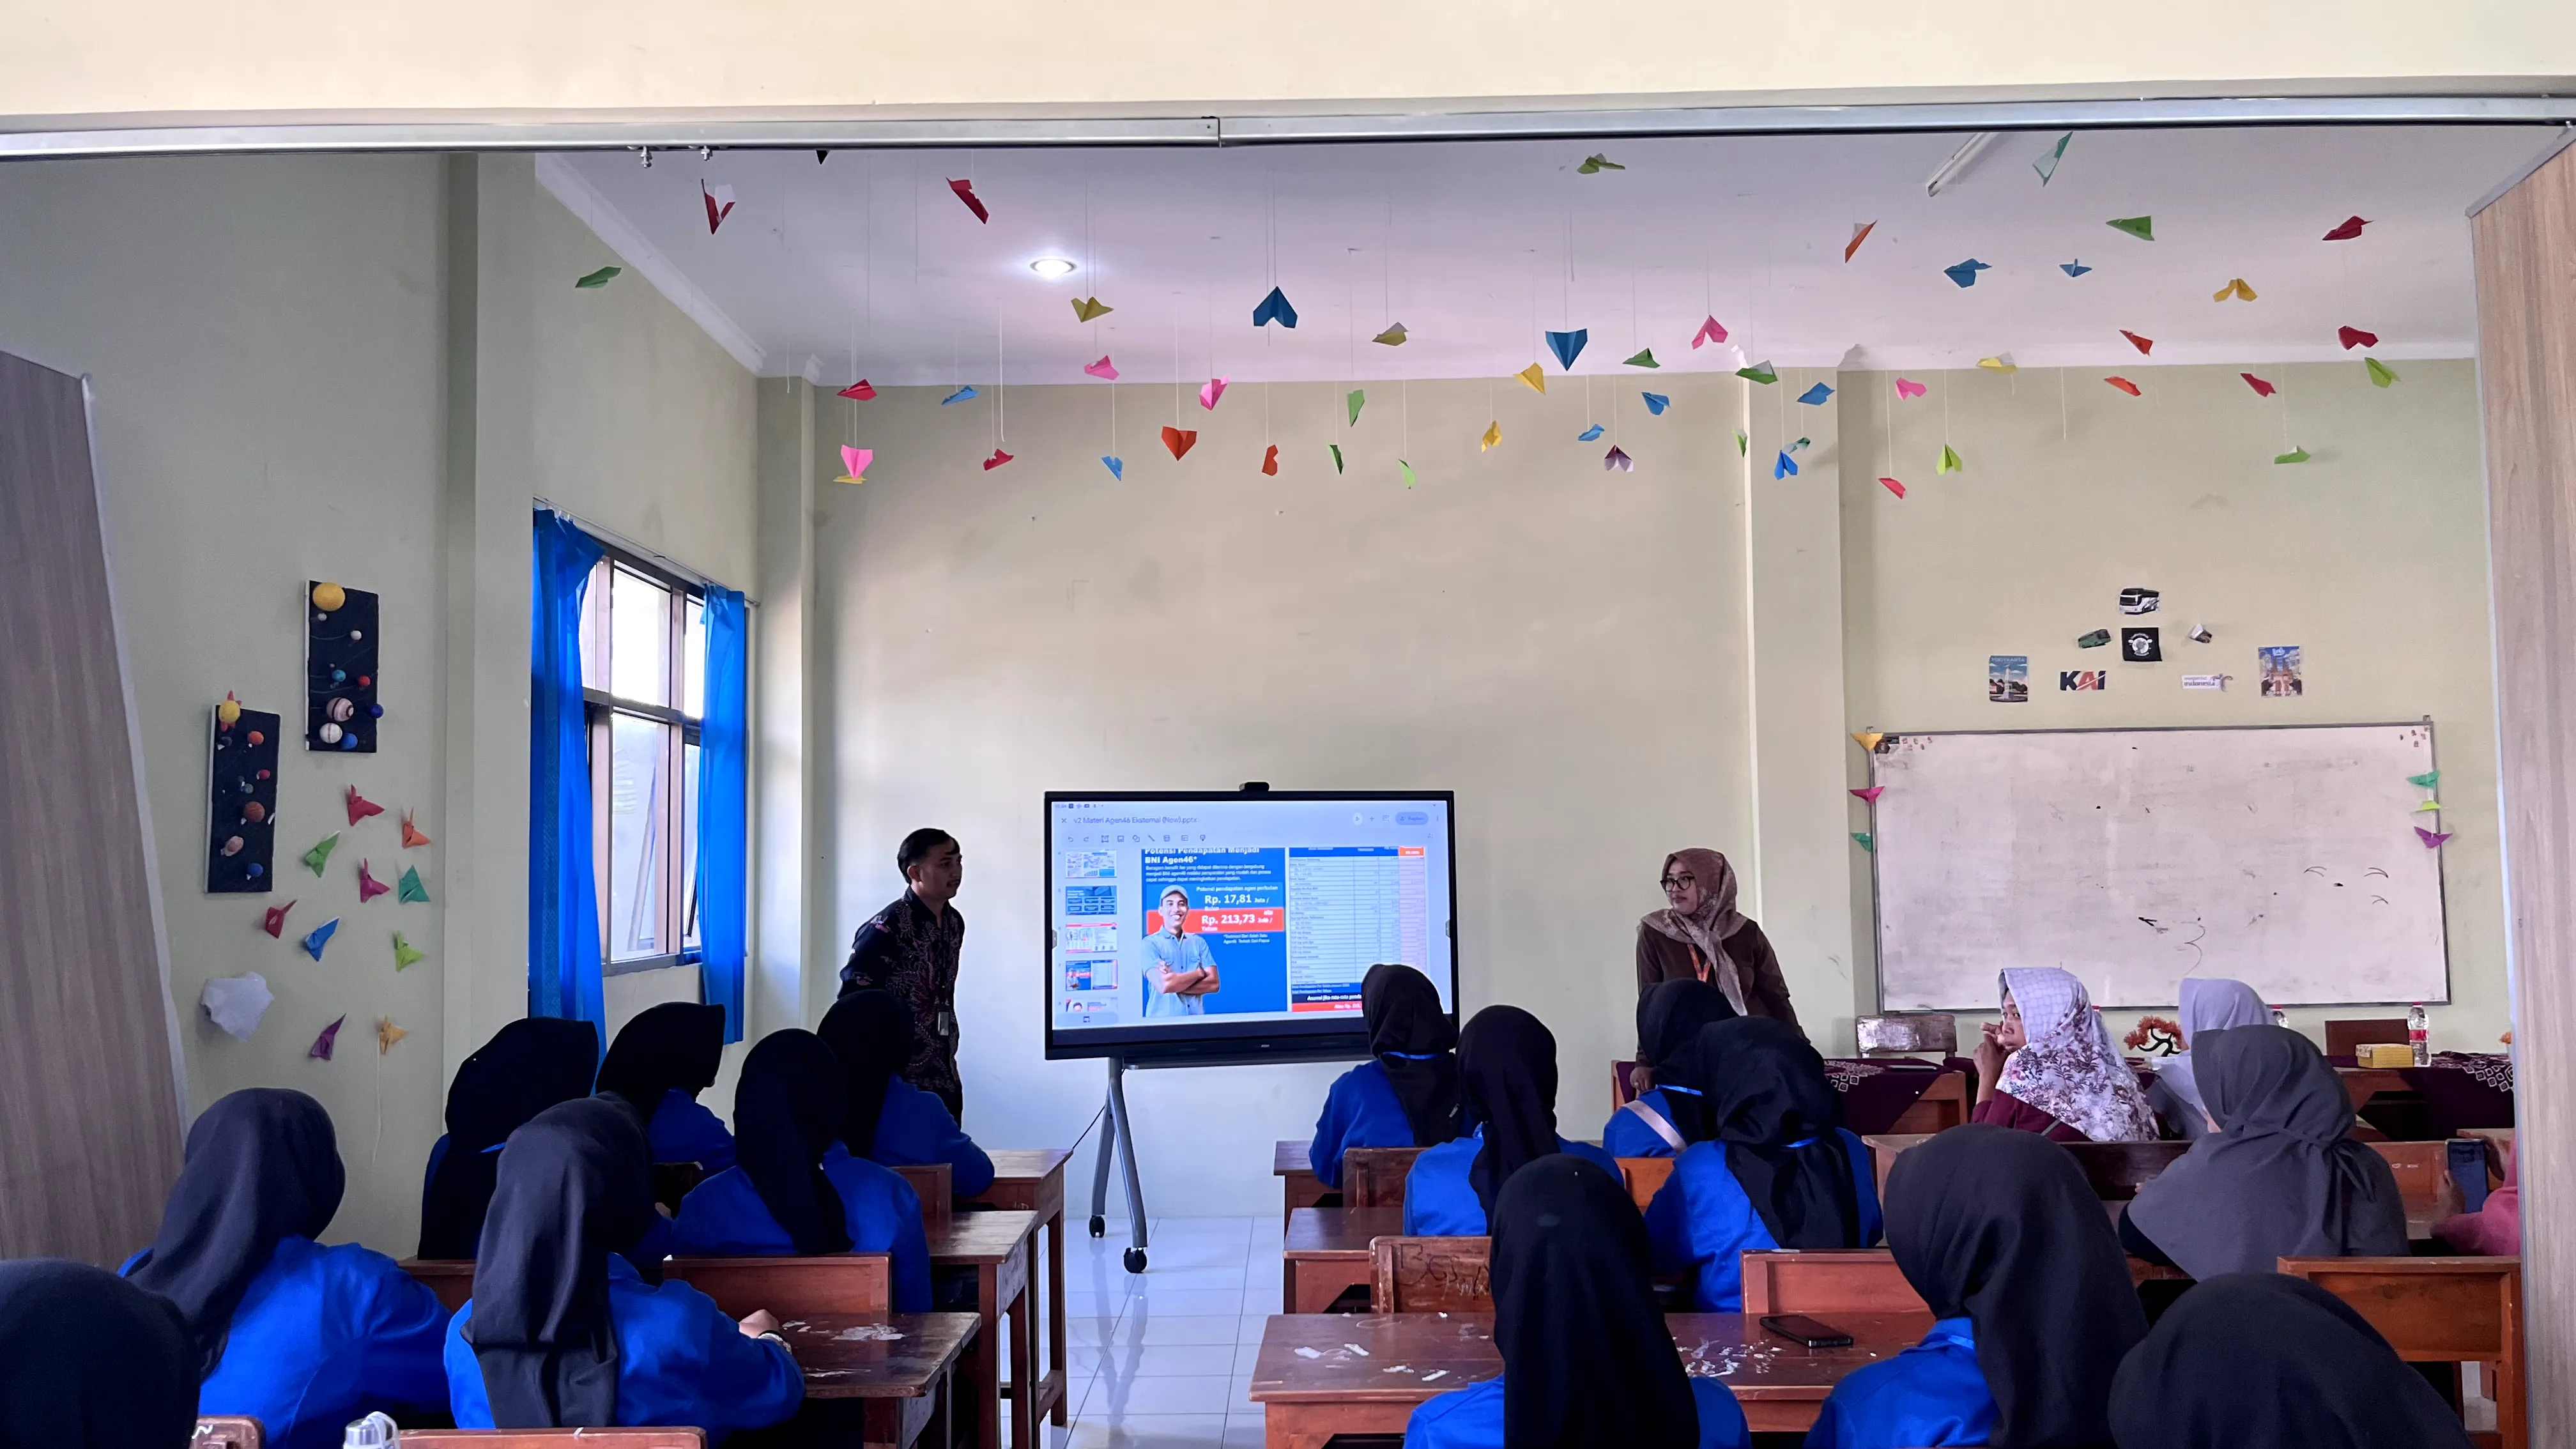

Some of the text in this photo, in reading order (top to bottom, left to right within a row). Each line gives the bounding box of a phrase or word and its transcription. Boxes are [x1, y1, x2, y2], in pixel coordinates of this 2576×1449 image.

[2060, 670, 2106, 691] KAI
[1204, 895, 1222, 905] Rp.
[1224, 894, 1252, 905] 17,81
[1202, 915, 1218, 926] Rp.
[1221, 914, 1255, 925] 213,73
